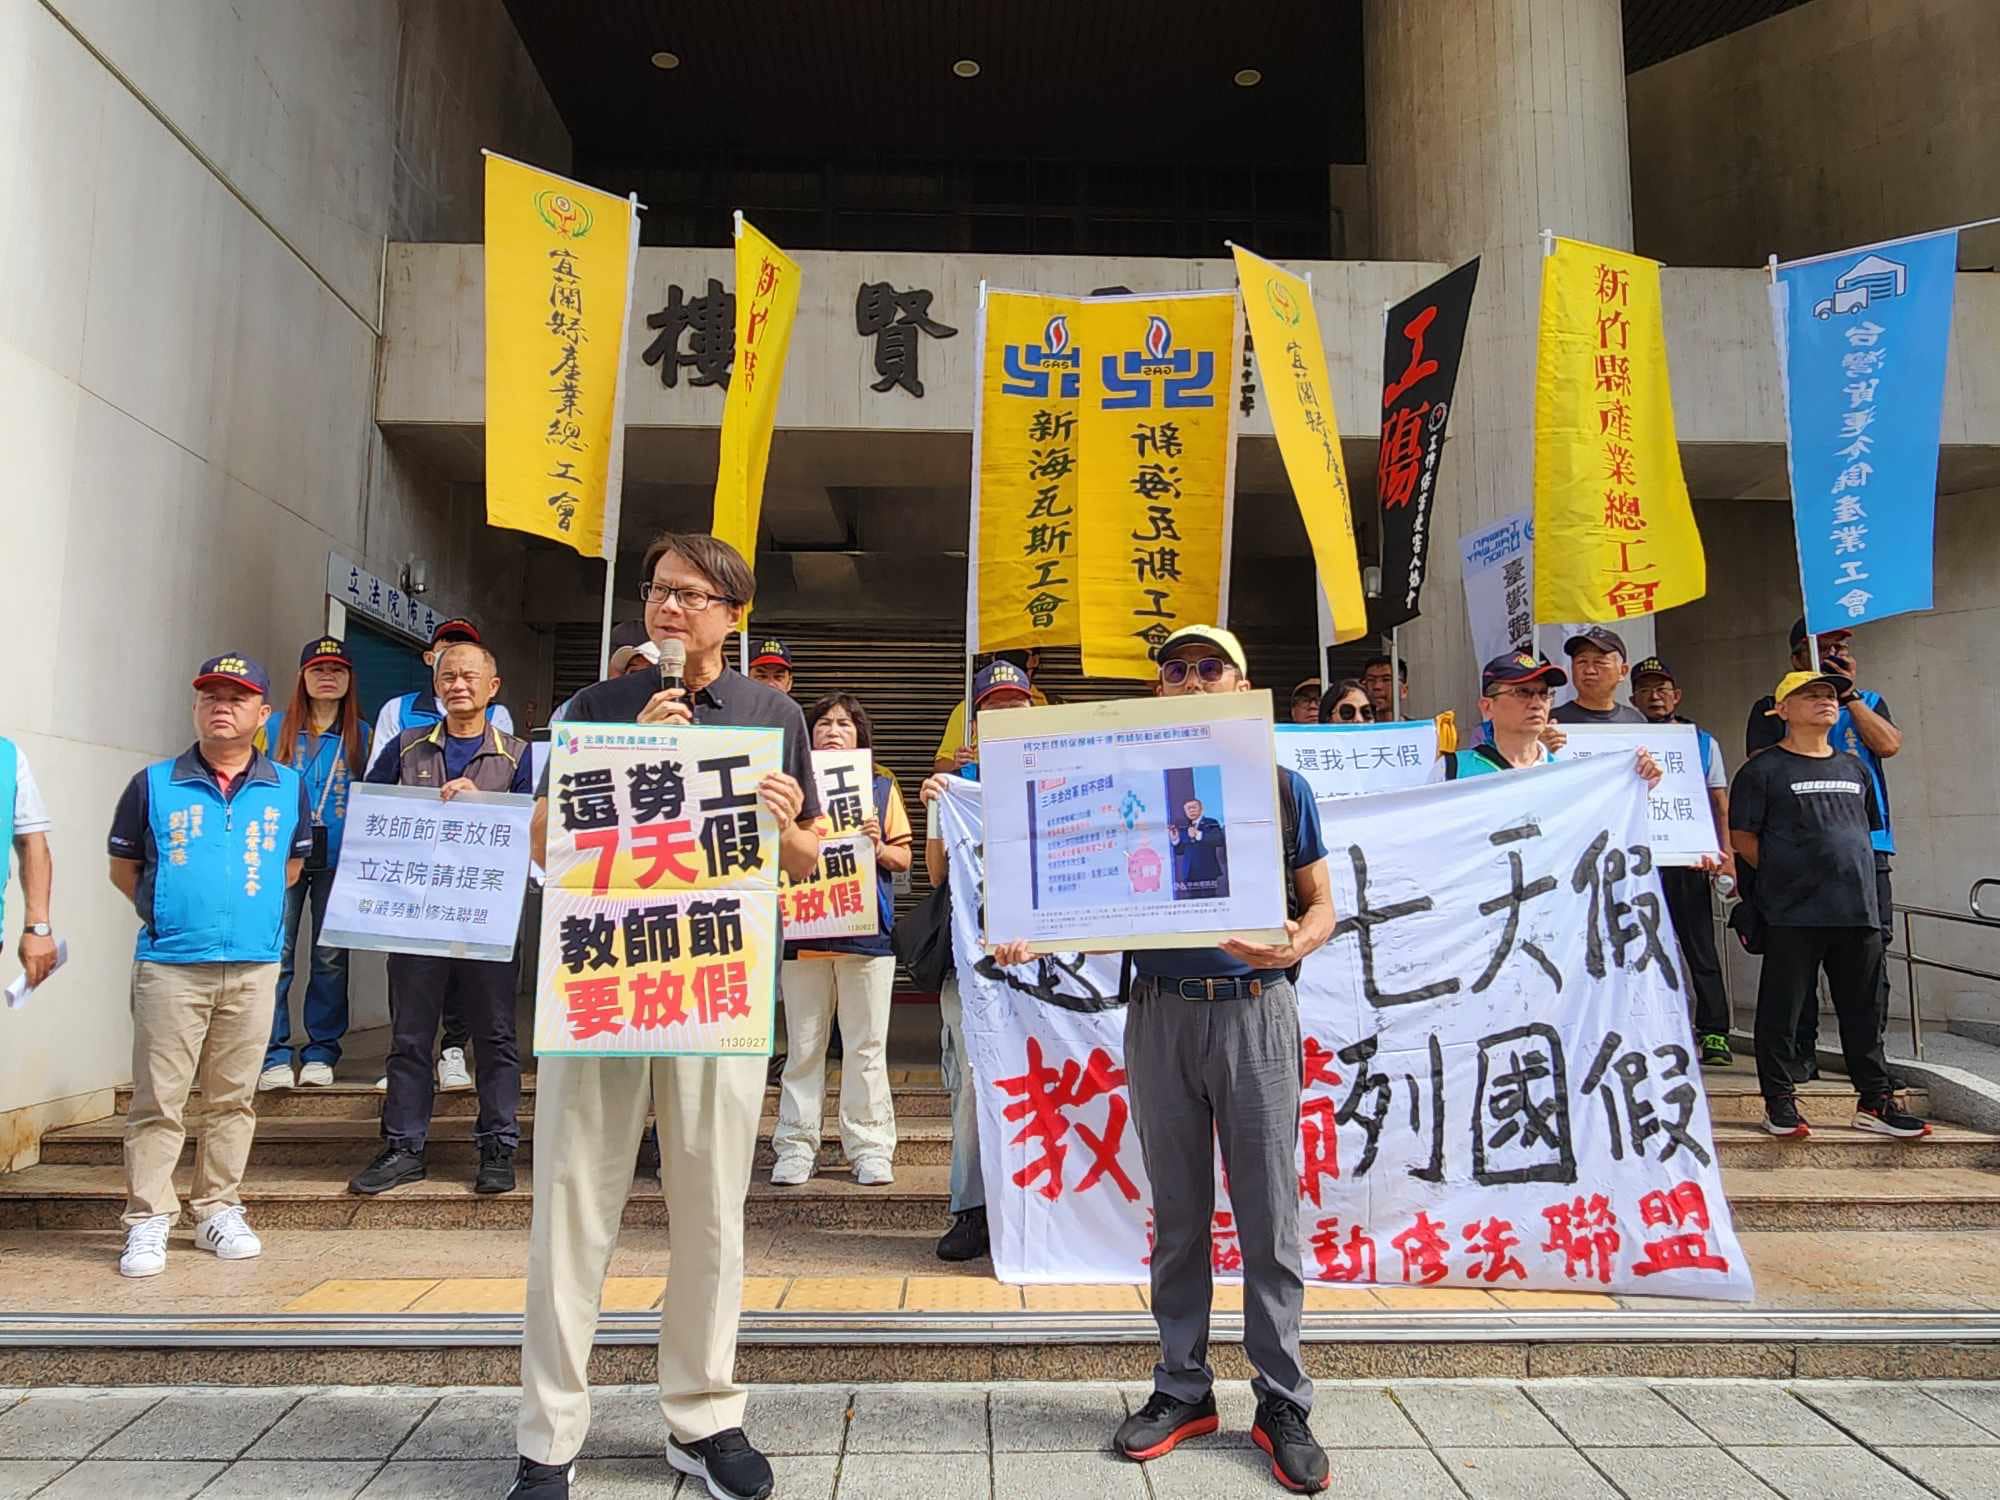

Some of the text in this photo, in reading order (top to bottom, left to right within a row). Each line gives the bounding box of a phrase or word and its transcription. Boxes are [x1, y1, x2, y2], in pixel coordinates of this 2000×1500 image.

[545, 248, 589, 532] 宜蘭縣產業總工會
[1042, 360, 1070, 370] GAS
[1593, 263, 1661, 618] 新竹縣產業總工會
[1023, 409, 1078, 629] 新海瓦斯工會
[1294, 744, 1422, 771] 還我七天假
[558, 754, 757, 832] 還勞工
[818, 795, 865, 836] 假
[365, 813, 511, 848] 教師節要放假
[575, 811, 765, 897] 7天假
[357, 858, 505, 892] 立法院請提案
[358, 898, 488, 925] 尊嚴勞動修法聯盟
[559, 898, 744, 975] 教師節
[564, 961, 752, 1041] 要放假
[719, 1037, 767, 1049] 1130927
